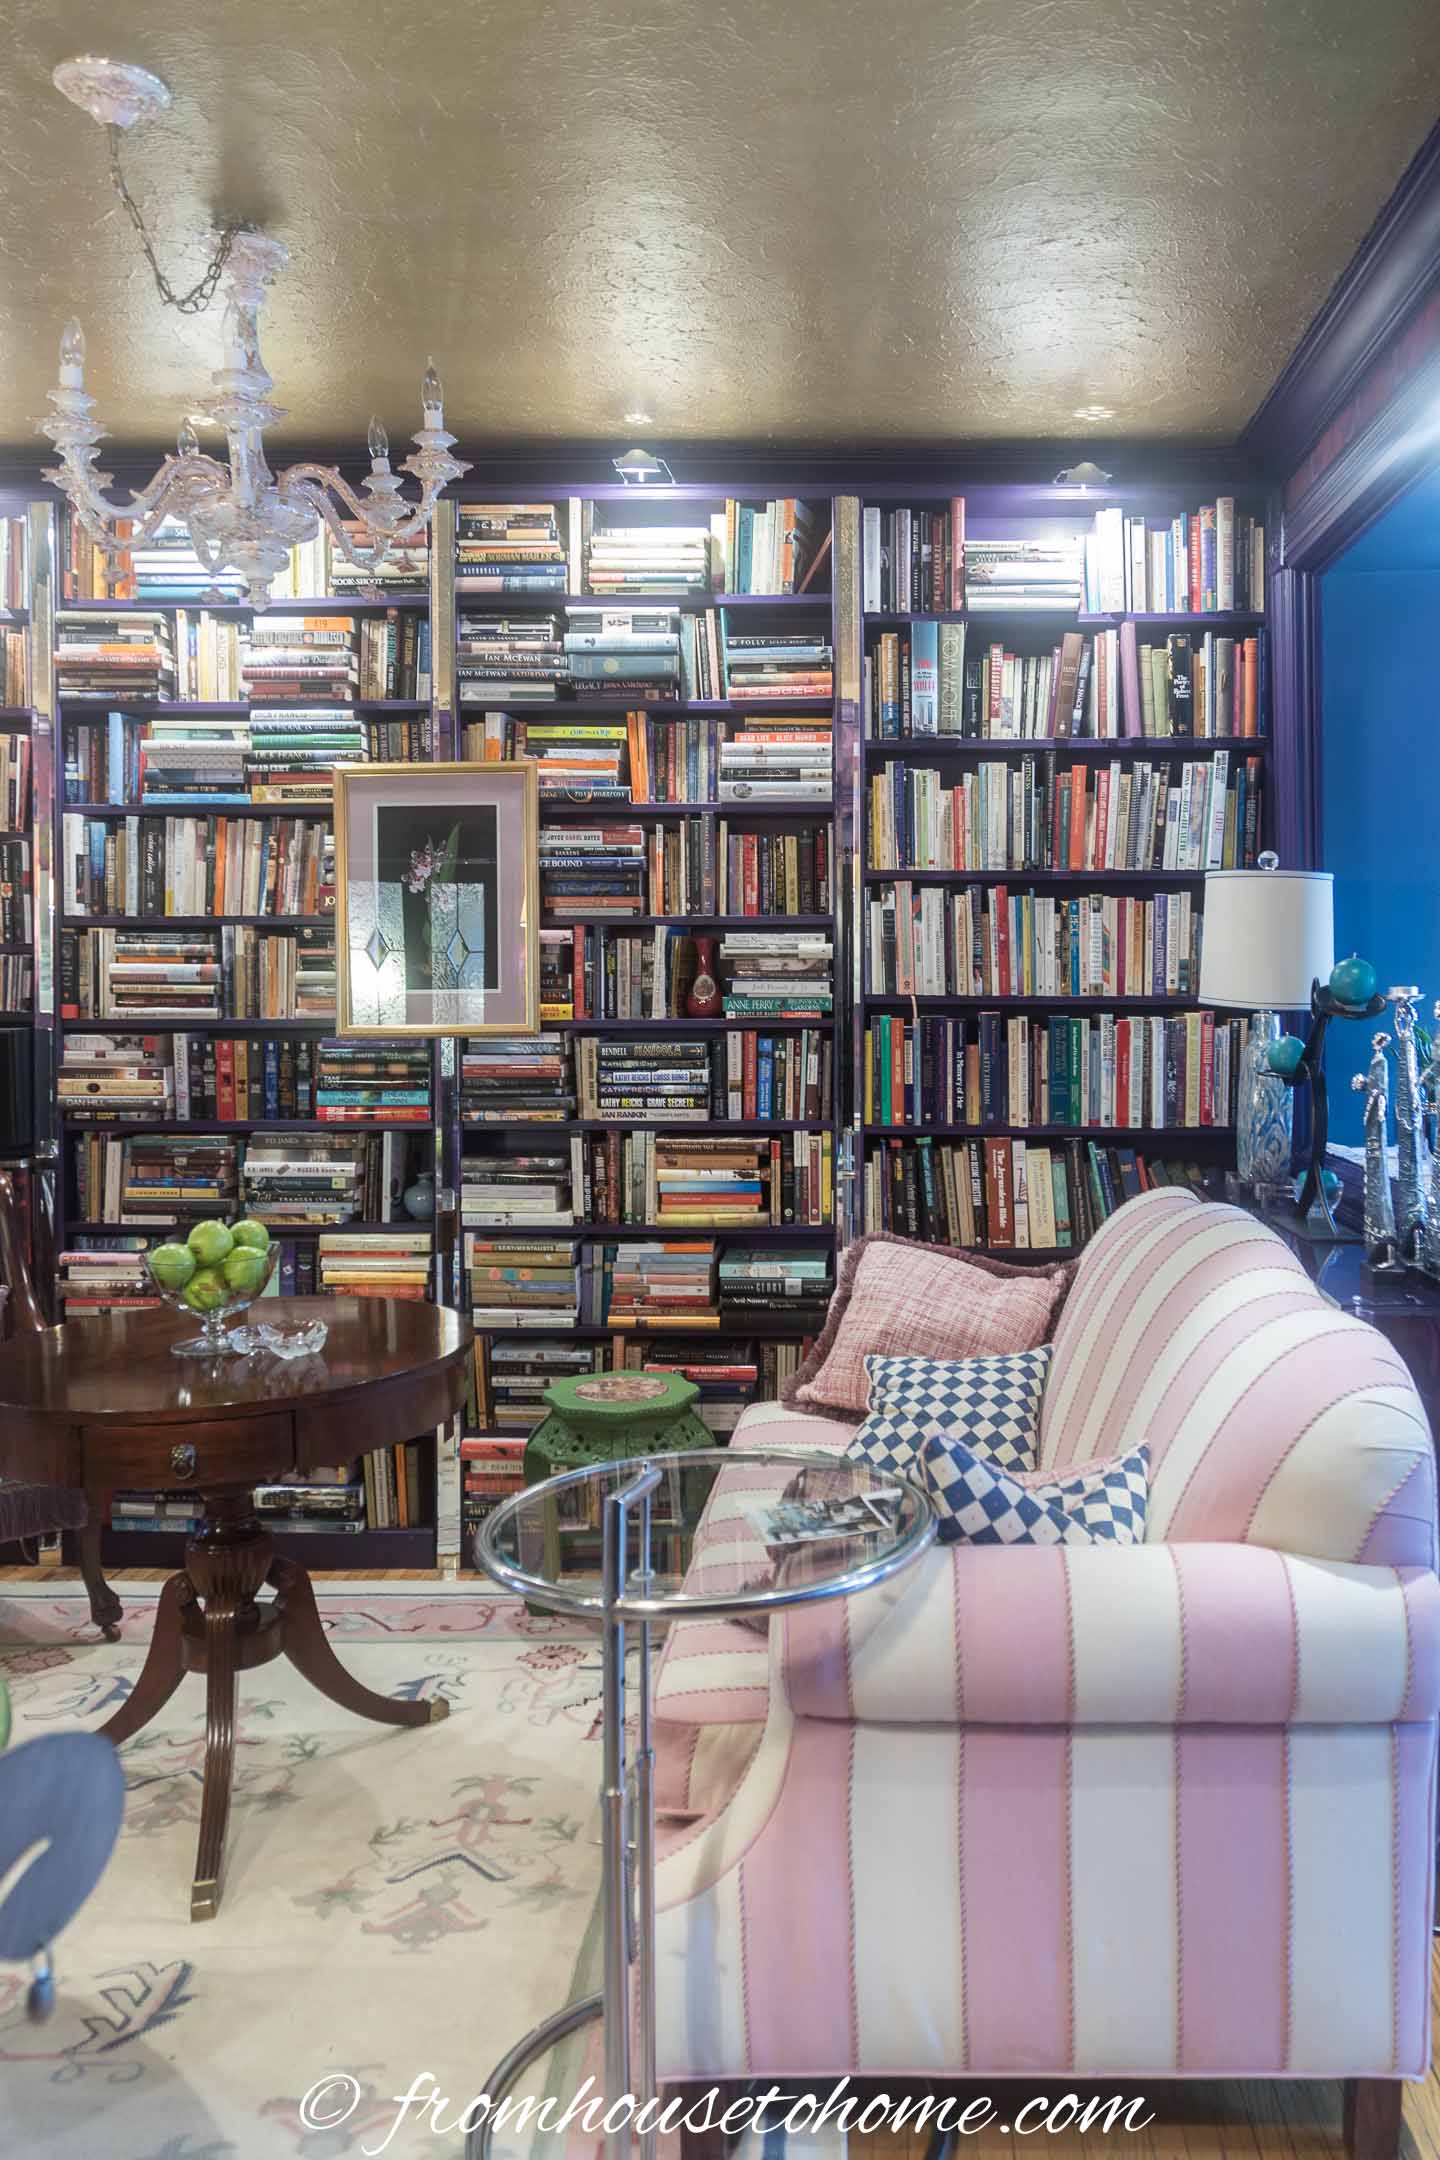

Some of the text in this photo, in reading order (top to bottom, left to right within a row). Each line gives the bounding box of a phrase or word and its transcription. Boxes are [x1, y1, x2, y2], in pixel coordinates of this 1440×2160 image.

[1076, 688, 1085, 709] SHACK
[728, 1000, 774, 1010] ANNE PERRY
[957, 1051, 964, 1059] In
[954, 1060, 964, 1086] Memory
[601, 1097, 694, 1107] KATHY REICHS GRAVE SECRETS
[595, 1156, 605, 1167] ANN
[972, 1179, 981, 1206] CHRISTIAN
[996, 1149, 1007, 1228] The Jerusalem Bible
